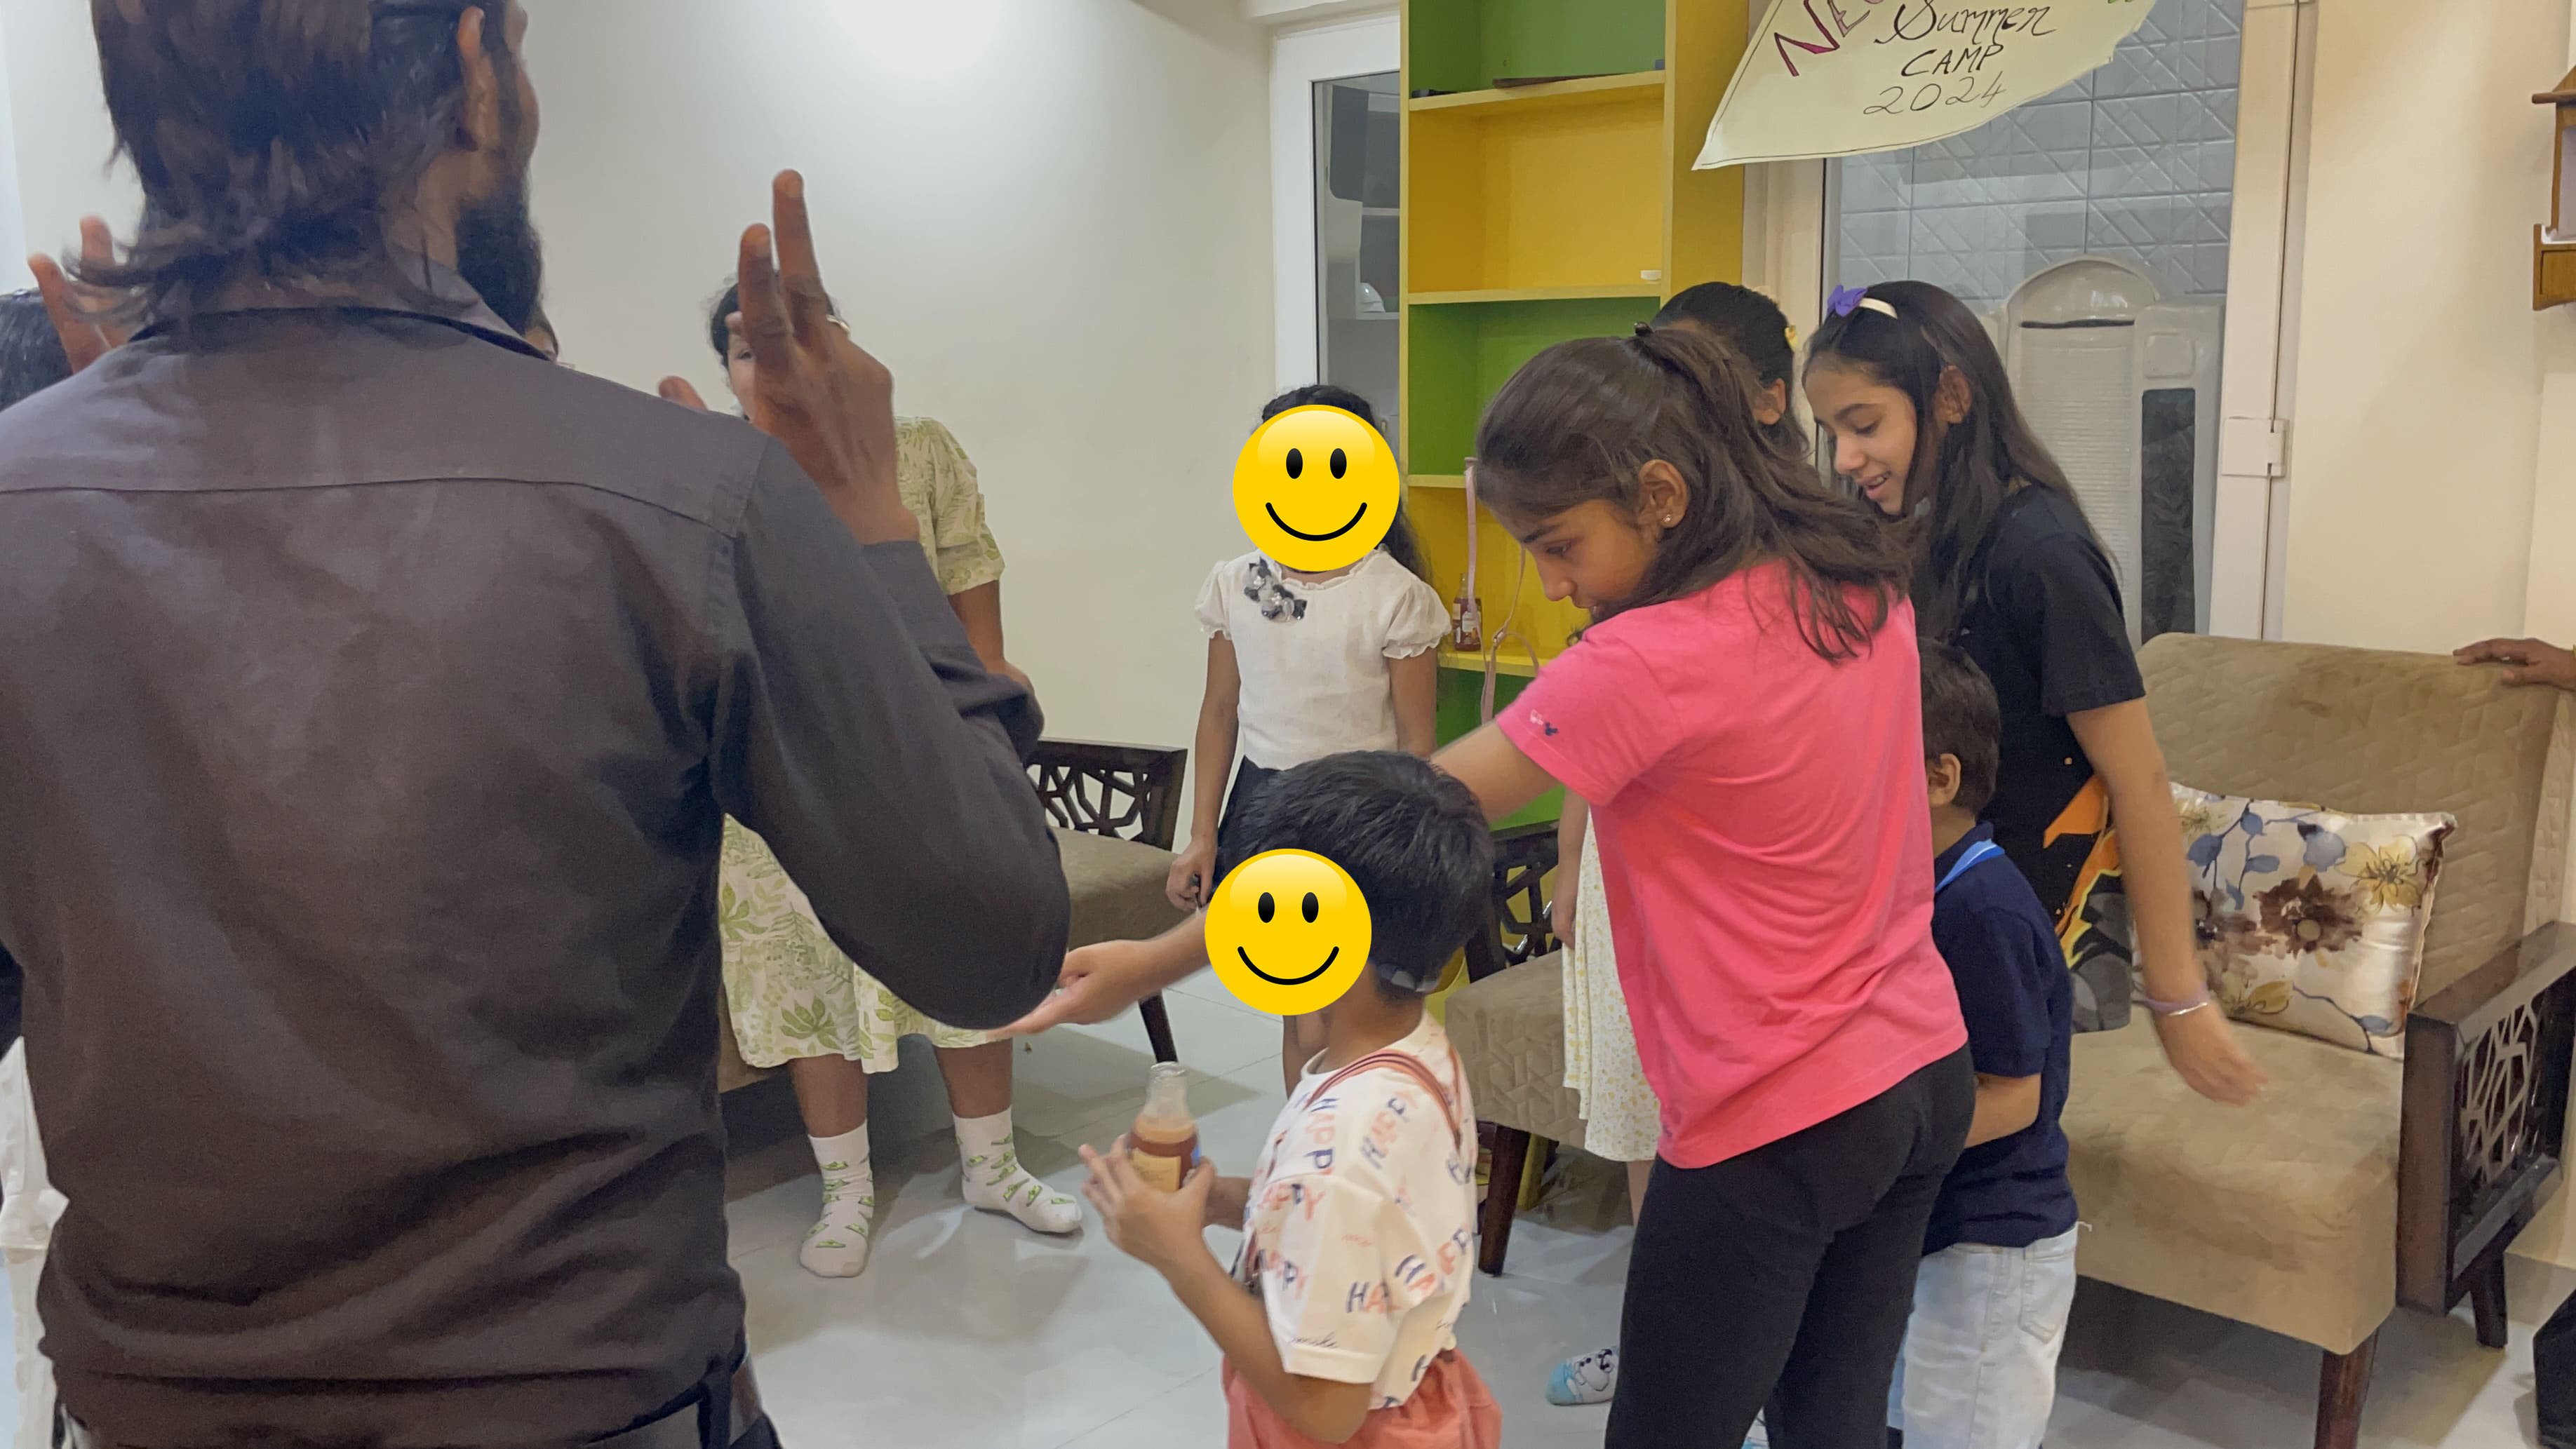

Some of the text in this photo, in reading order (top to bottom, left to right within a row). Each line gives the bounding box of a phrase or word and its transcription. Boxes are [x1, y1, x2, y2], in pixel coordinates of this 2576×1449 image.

[1773, 0, 1885, 77] NE
[1873, 0, 2058, 46] Summer
[1900, 44, 2004, 77] CAMP
[1863, 71, 2007, 115] 2024
